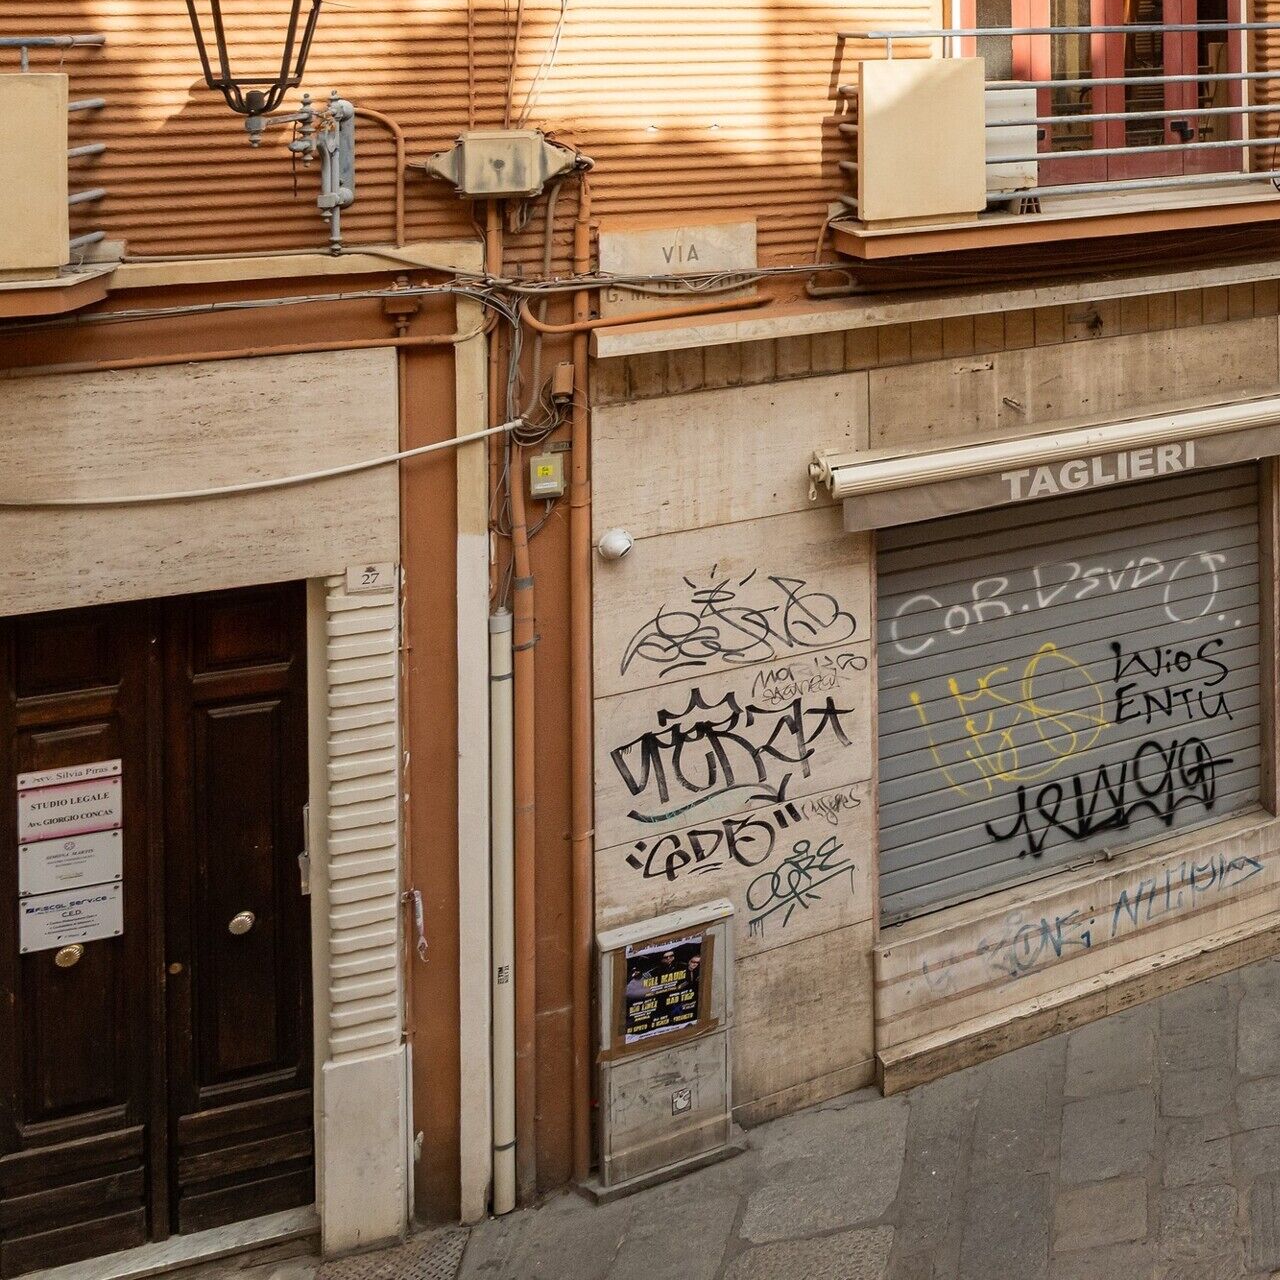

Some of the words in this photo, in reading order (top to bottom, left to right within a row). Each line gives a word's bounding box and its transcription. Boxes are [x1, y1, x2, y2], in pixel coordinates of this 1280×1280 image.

[662, 244, 699, 264] VIA
[1002, 441, 1197, 501] TAGLIERI
[361, 572, 380, 585] 27
[56, 769, 83, 780] Silvia
[85, 767, 109, 775] Piras
[30, 799, 68, 811] STUDIO
[70, 792, 110, 803] LEGALE
[43, 814, 79, 826] GIORGIO
[80, 808, 114, 819] CONCAS
